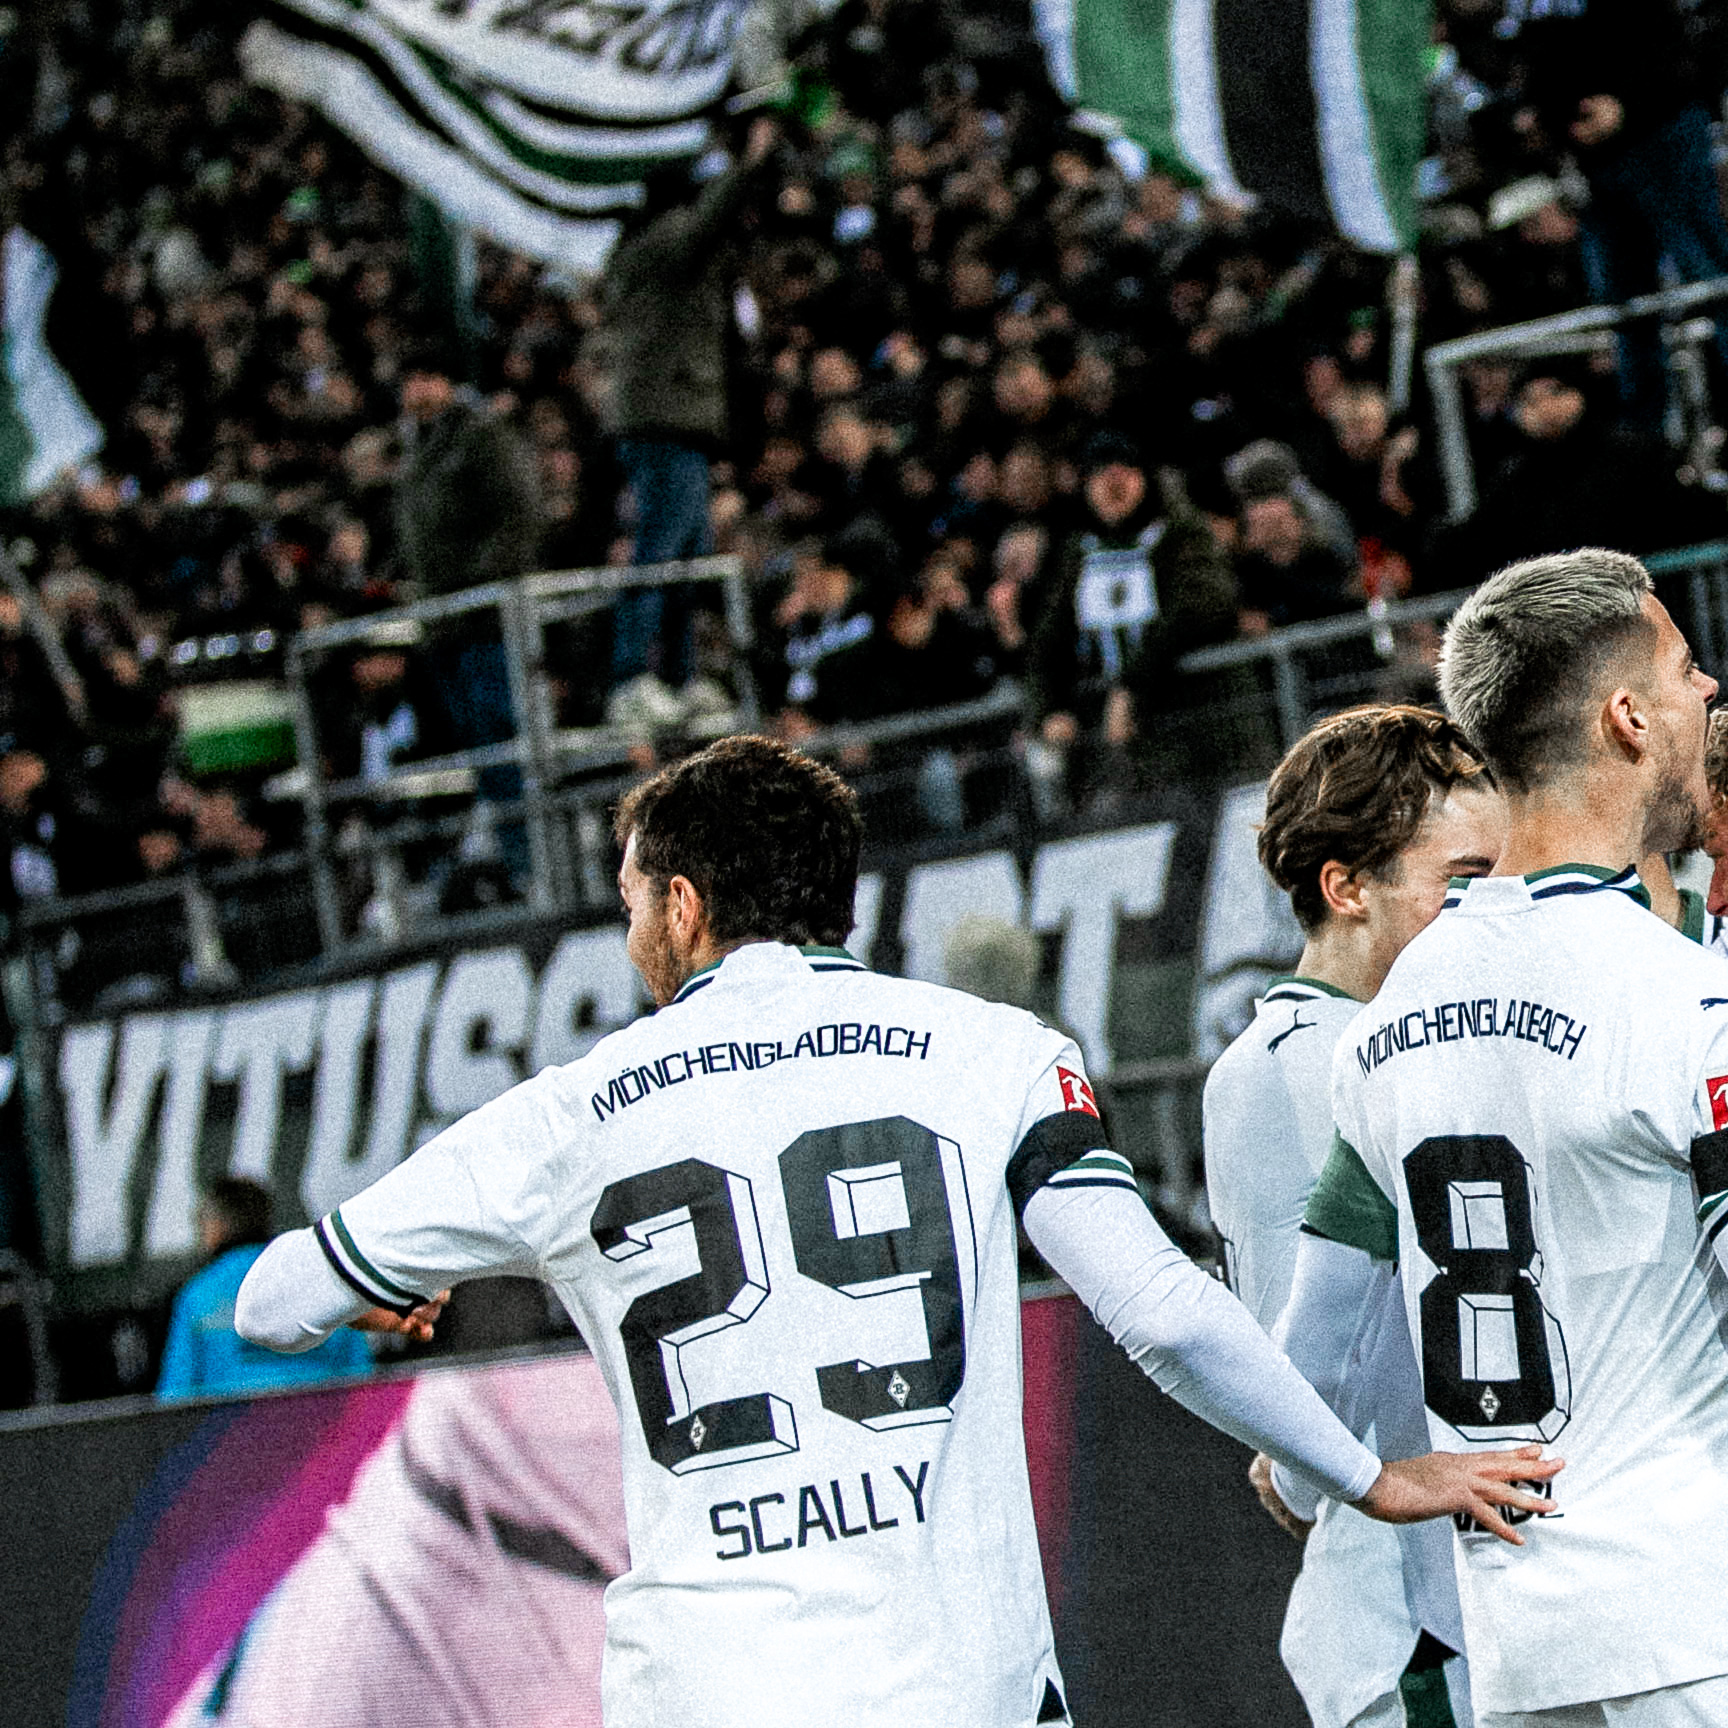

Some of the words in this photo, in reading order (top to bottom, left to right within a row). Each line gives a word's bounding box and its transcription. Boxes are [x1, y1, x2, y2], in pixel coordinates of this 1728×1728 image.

[590, 1022, 931, 1122] MÖNCHENGLADBACH
[589, 1114, 979, 1478] 29
[1402, 1133, 1572, 1444] 8
[709, 1460, 931, 1562] SCALLY
